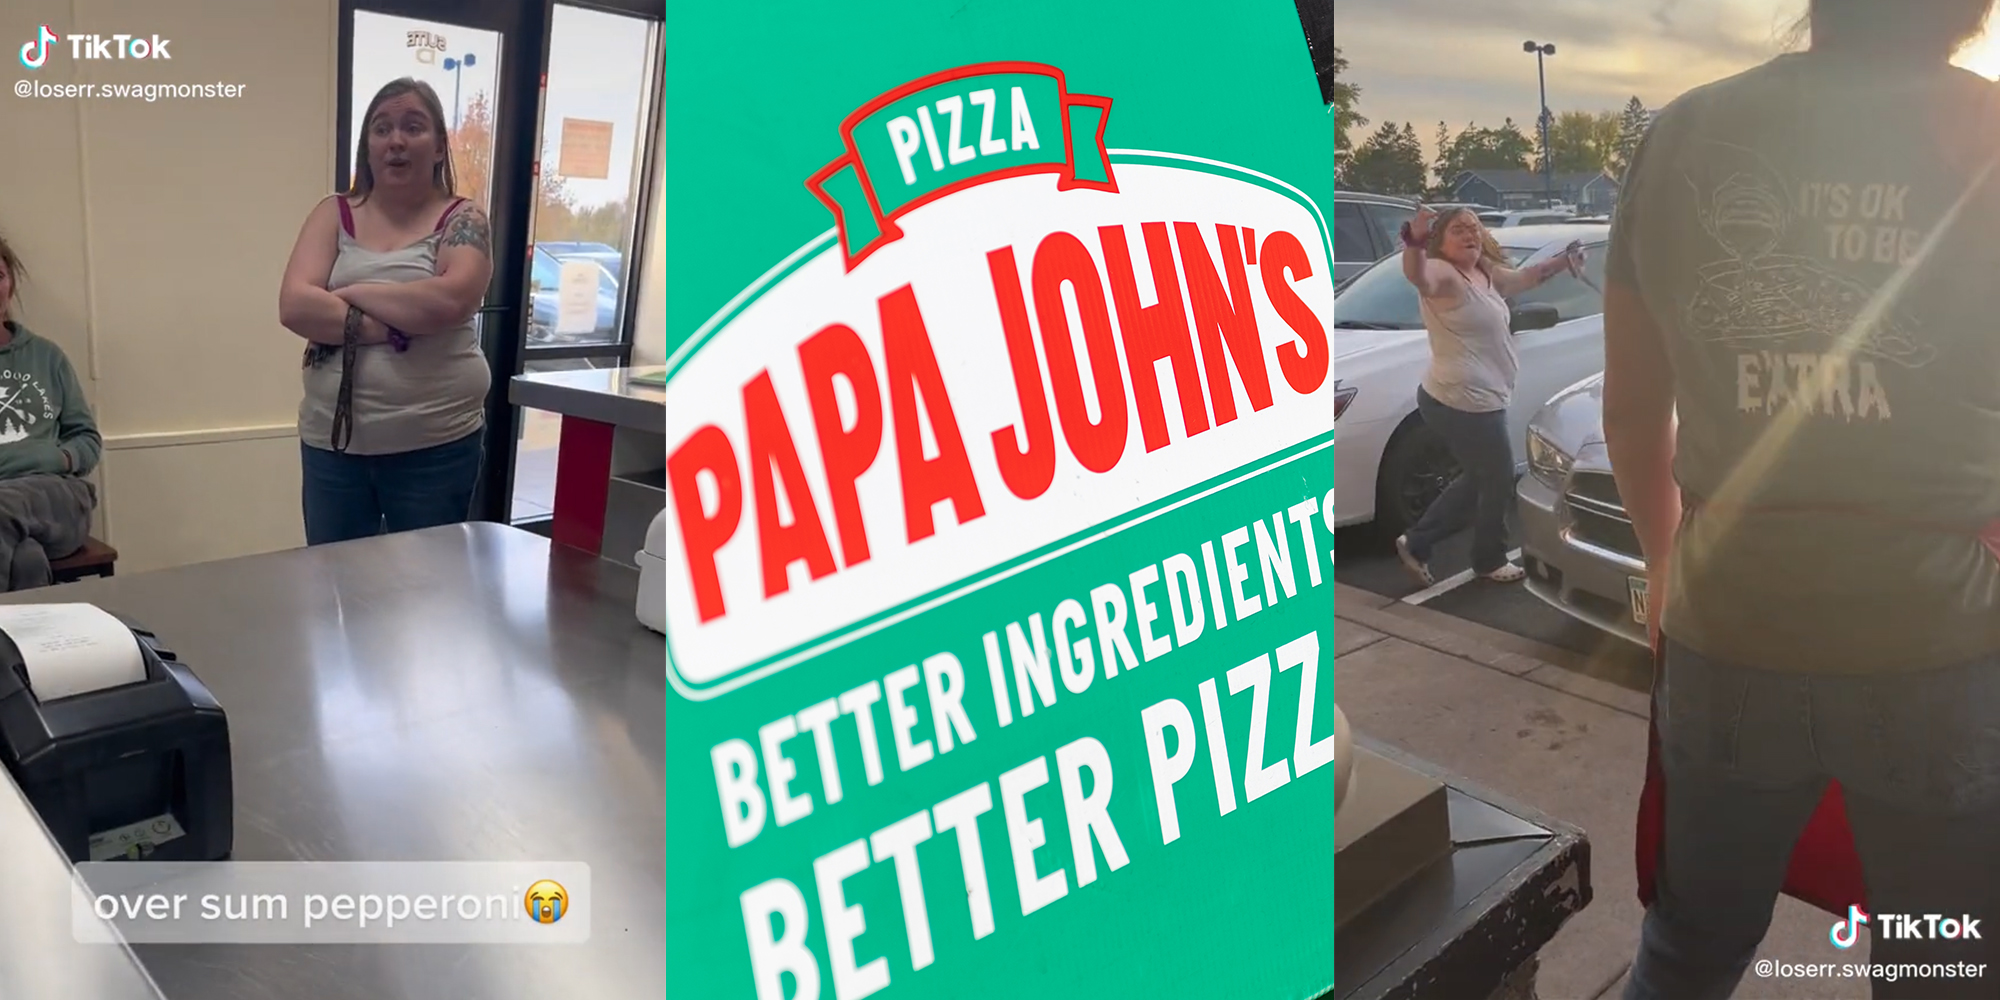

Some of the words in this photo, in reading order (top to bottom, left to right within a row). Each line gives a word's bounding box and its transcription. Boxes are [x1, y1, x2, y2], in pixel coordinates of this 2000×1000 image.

[886, 86, 1040, 185] PIZZA
[1800, 182, 1852, 220] IT'S
[1860, 183, 1910, 221] OK
[1823, 223, 1867, 263] TO
[667, 283, 985, 624] PAPA
[987, 222, 1330, 501] JOHN'S
[1737, 349, 1892, 424] EXTRA
[710, 651, 977, 848] BETTER
[739, 736, 1131, 1000] BETTER
